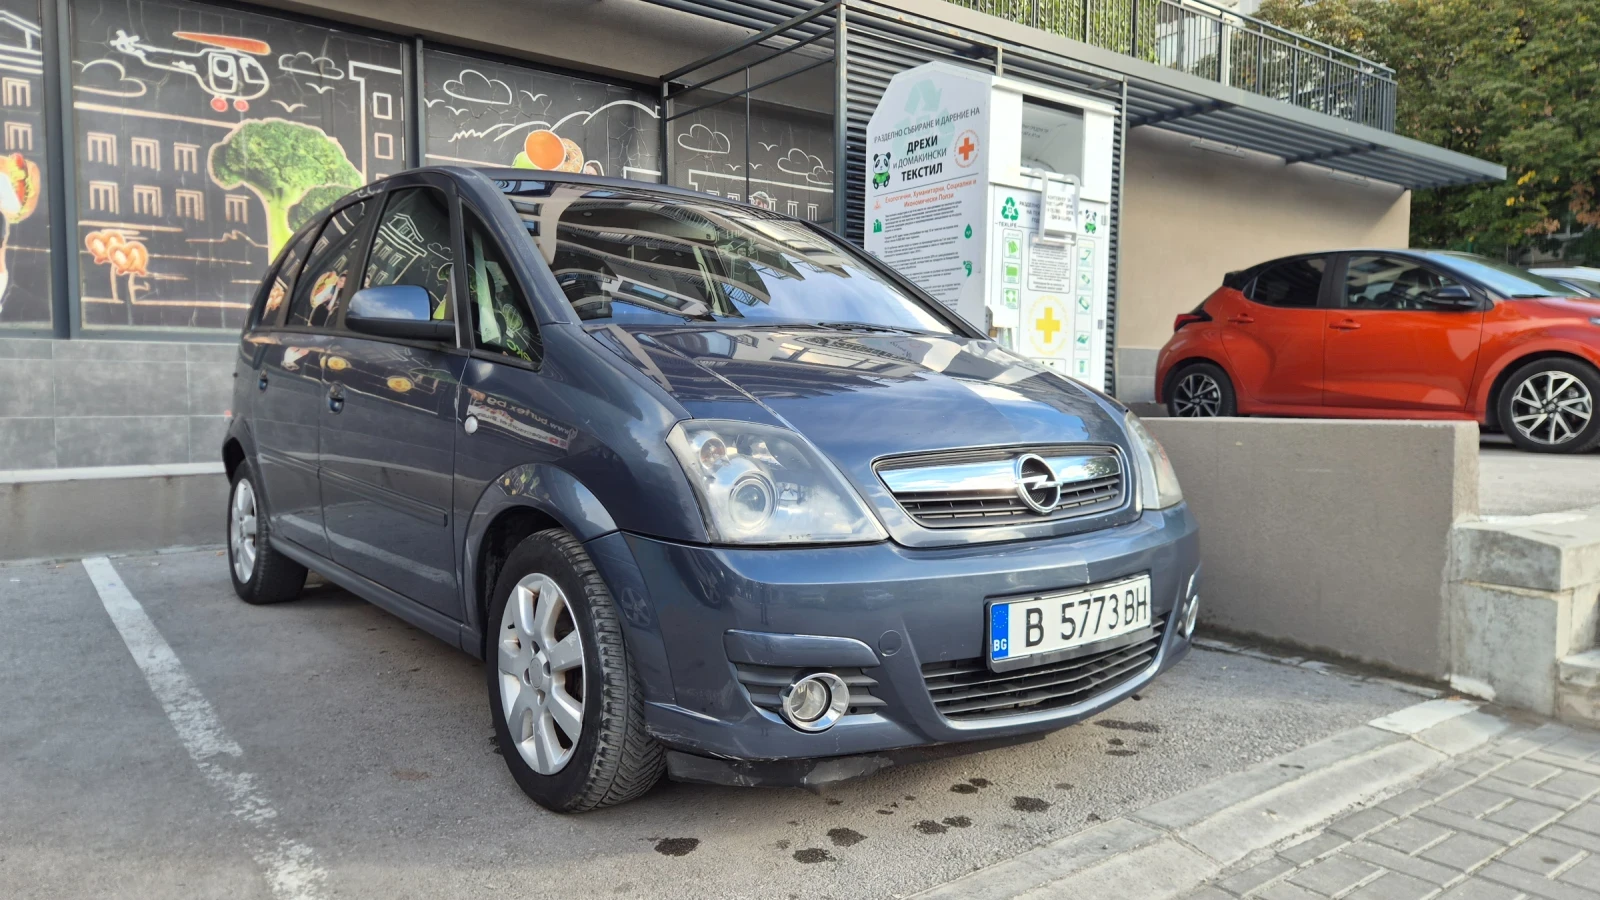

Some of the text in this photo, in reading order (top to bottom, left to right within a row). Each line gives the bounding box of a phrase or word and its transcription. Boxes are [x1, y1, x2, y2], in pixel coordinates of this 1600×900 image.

[874, 107, 980, 143] РАЗДЕЛНО СЪБИРАНЕ И ДАРЕНИЕ НА
[906, 135, 938, 155] ДРЕХИ
[898, 148, 947, 169] ДОМАКИНСКИ
[901, 162, 943, 182] ТЕКСТИЛ
[946, 180, 972, 191] Социални
[904, 192, 954, 208] Икономически Ползи
[1025, 585, 1147, 648] B 5773 BH
[993, 639, 1007, 651] BG
